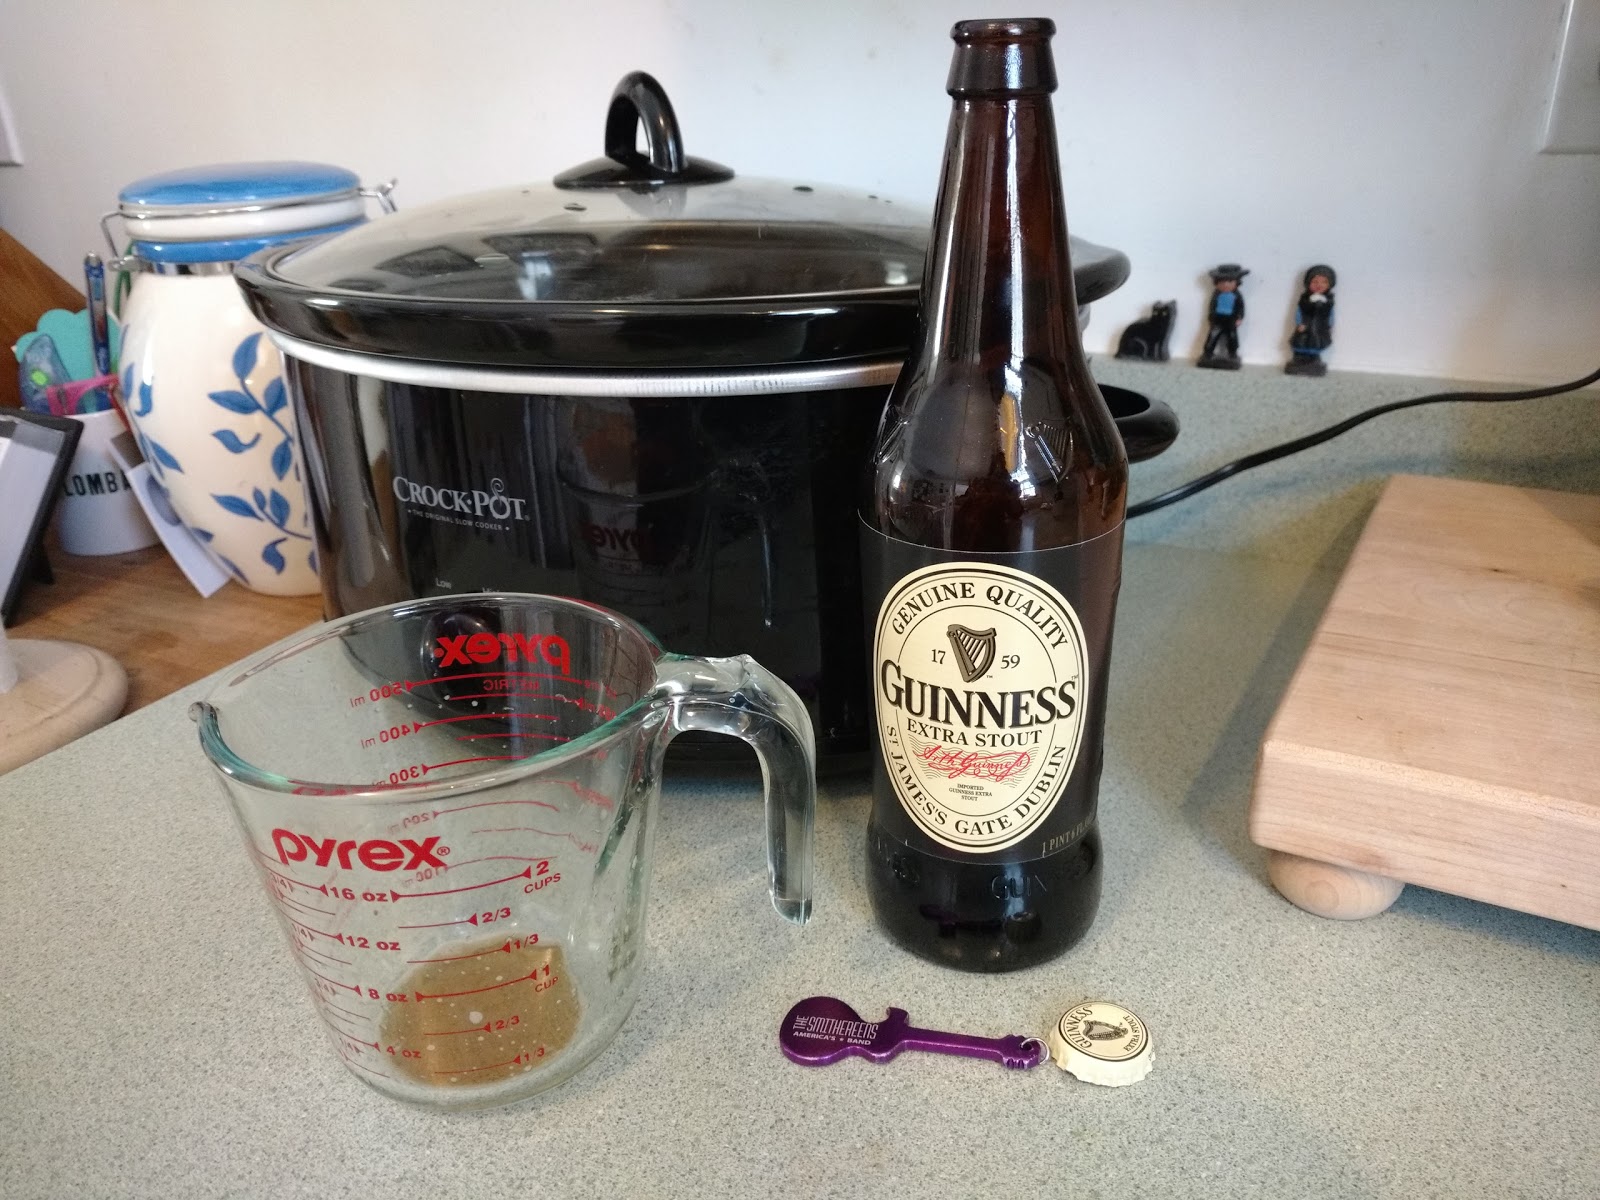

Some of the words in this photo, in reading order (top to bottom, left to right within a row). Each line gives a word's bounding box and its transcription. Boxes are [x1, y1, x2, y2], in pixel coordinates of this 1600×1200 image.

[425, 512, 454, 524] ORIGINAL
[455, 517, 473, 527] SLOW
[475, 521, 503, 531] COOKER
[892, 582, 975, 635] GENUINE
[986, 585, 1068, 650] QUALITY
[931, 649, 946, 665] 17
[1000, 654, 1021, 670] 59
[881, 659, 1076, 729] GUINNESS
[907, 717, 969, 746] EXTRA
[975, 730, 1042, 748] STOUT
[891, 751, 947, 825] JAMES'S
[954, 814, 1013, 836] GATE
[1013, 745, 1066, 819] DUBLIN
[949, 787, 975, 796] GUINNESS
[957, 783, 984, 791] IMPORTED
[1049, 831, 1071, 850] PINT
[536, 860, 550, 877] 2
[524, 873, 562, 895] CUPS
[330, 886, 356, 901] 16
[362, 890, 388, 903] oz
[482, 907, 511, 924] 2/3
[346, 935, 371, 950] 12
[376, 939, 401, 952] oz
[515, 933, 539, 950] 1/3
[542, 964, 550, 977] 1
[534, 977, 559, 993] CUP
[369, 988, 381, 1001] 8
[386, 990, 409, 1003] oz
[495, 1015, 521, 1031] 2/3
[793, 1015, 810, 1030] THE
[807, 1016, 879, 1040] SMITHEREENS
[1065, 1006, 1093, 1049] GUINNESS
[793, 1031, 836, 1041] AMERICA'S
[847, 1037, 872, 1046] BAND
[1123, 1034, 1140, 1052] EXTRA
[402, 1048, 422, 1060] oz
[524, 1048, 546, 1063] 1/3
